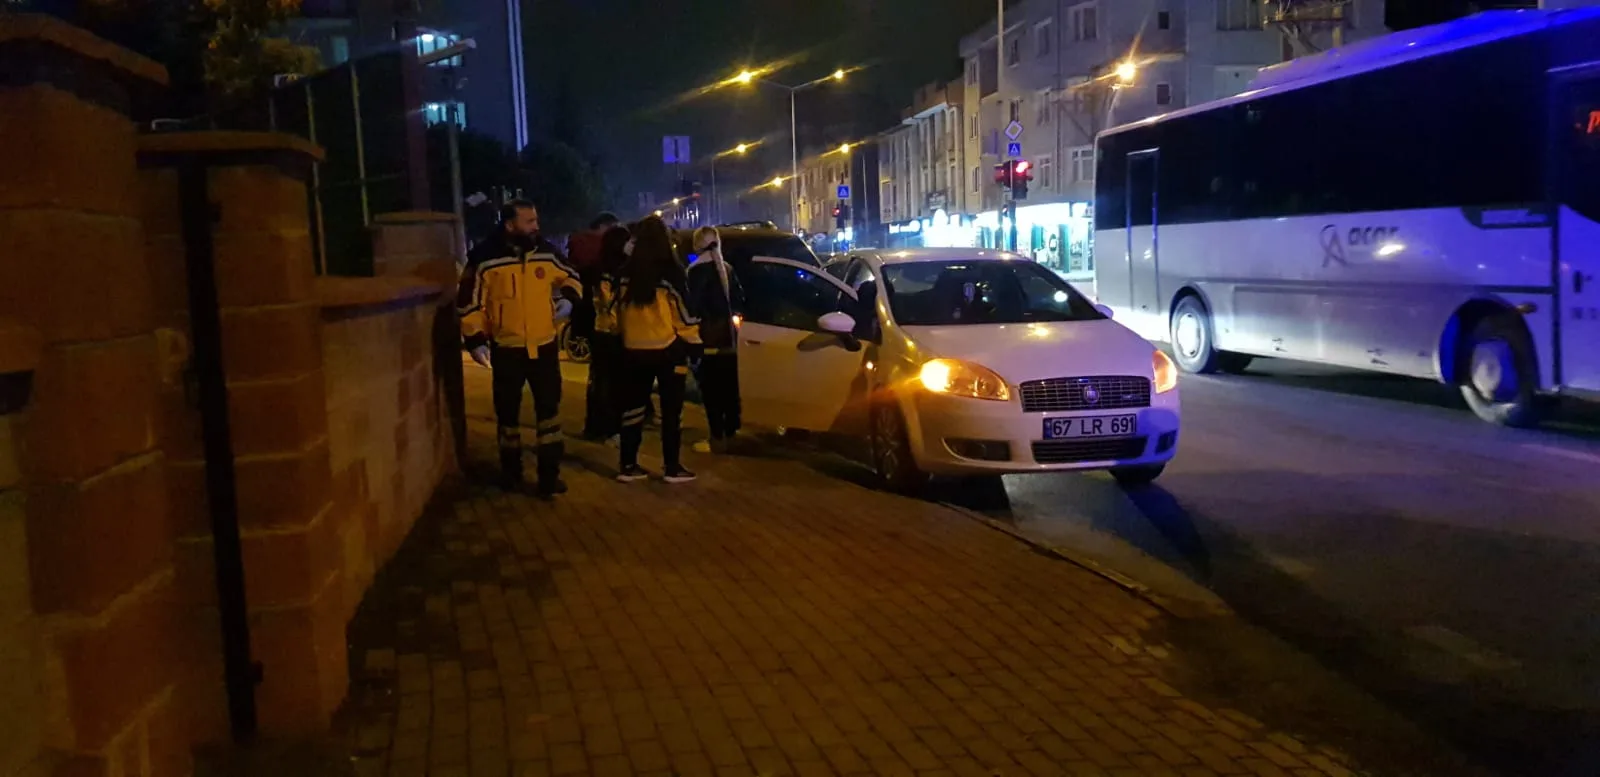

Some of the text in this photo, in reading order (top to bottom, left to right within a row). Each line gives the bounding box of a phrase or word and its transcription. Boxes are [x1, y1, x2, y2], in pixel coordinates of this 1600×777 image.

[1053, 417, 1135, 436] 67 LR 691
